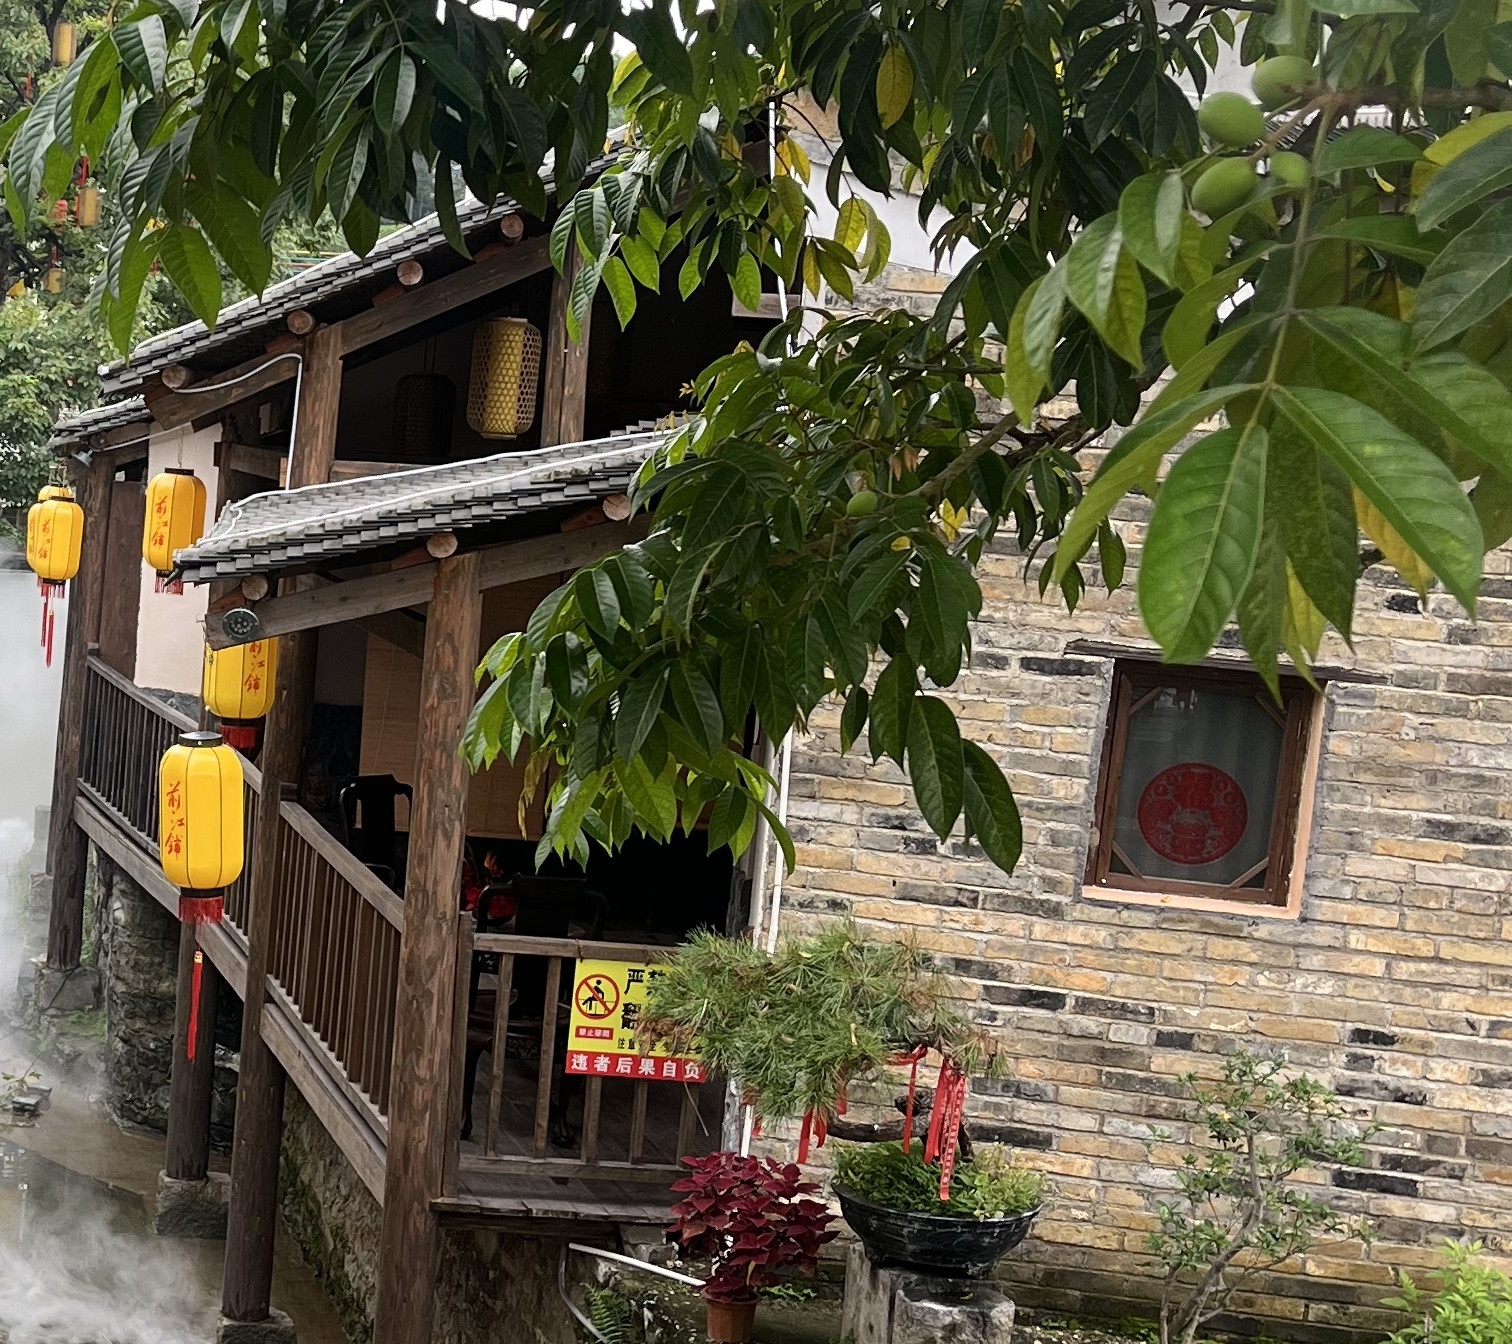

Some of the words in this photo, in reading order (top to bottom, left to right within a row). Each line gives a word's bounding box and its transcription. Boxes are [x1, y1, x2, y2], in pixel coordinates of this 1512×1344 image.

[570, 1053, 700, 1080] 违者后果自负
